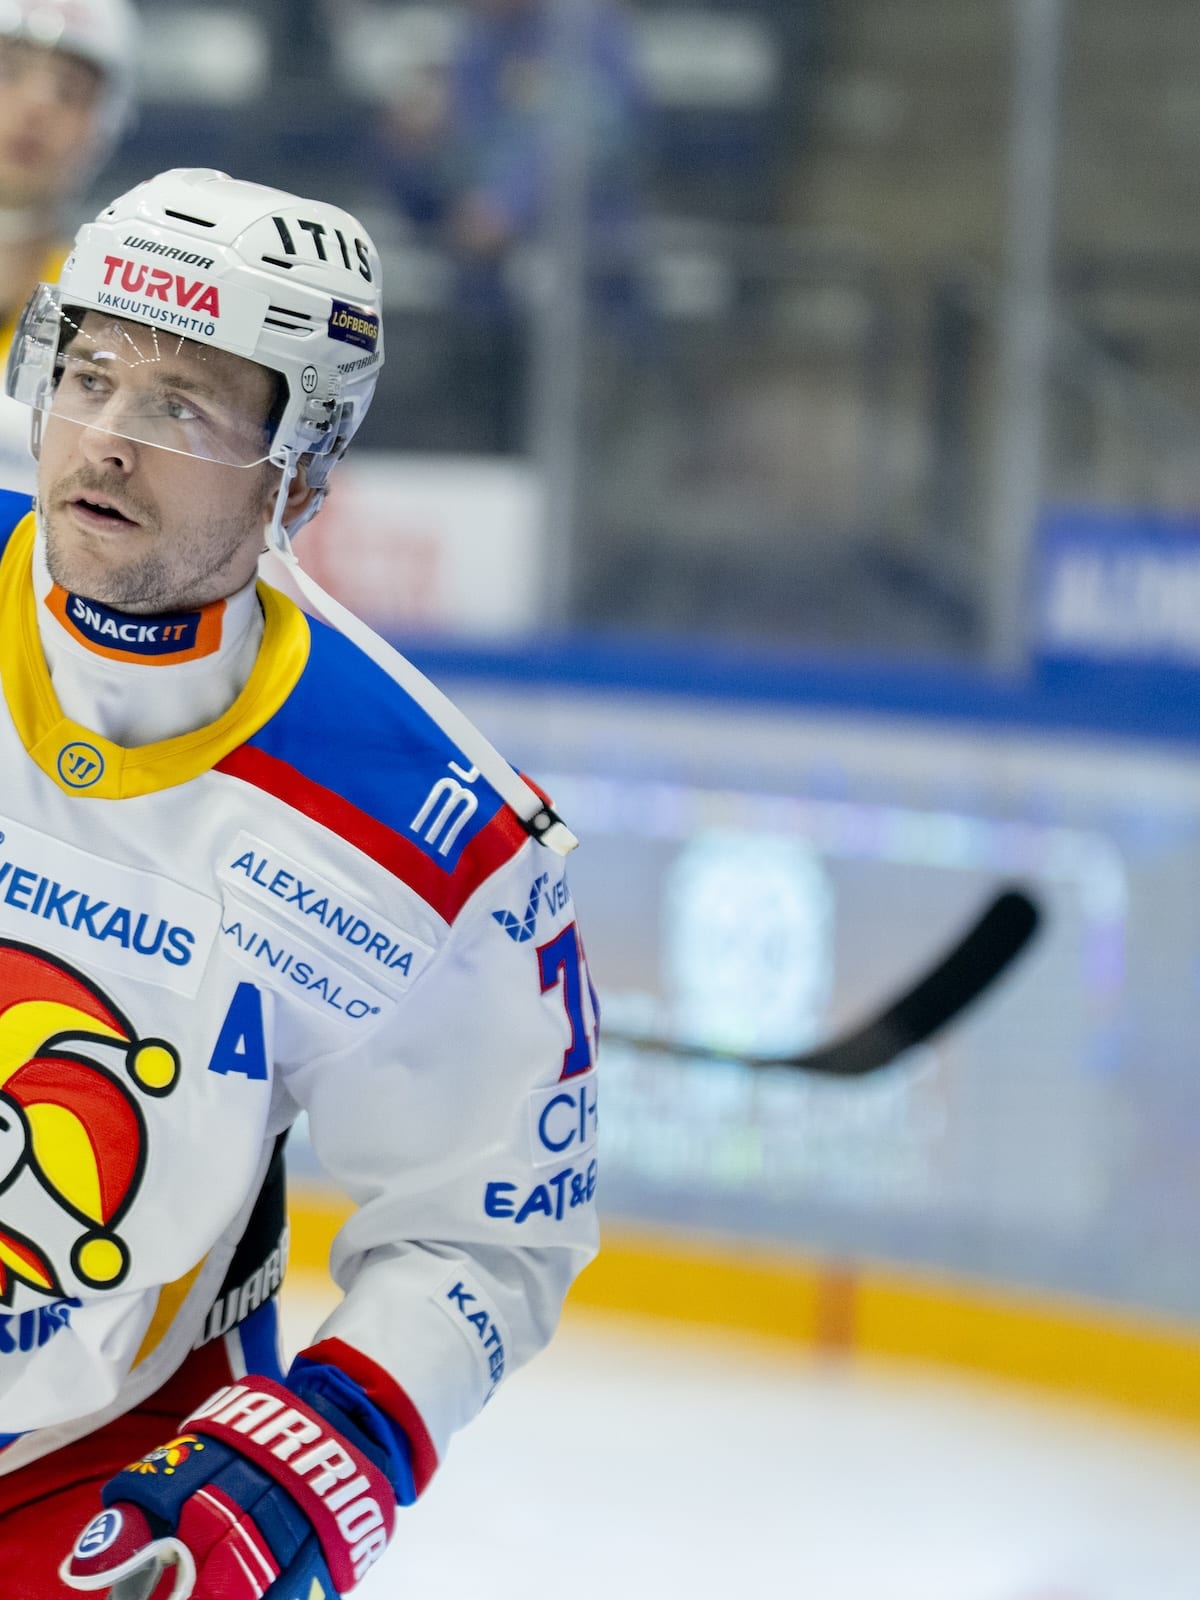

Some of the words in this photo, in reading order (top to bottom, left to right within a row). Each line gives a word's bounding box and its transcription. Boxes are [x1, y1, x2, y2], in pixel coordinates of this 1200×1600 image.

[123, 236, 215, 270] WARRIOR
[272, 216, 372, 283] ITIS
[98, 292, 215, 336] VAKUUTUSYHTIÖ
[104, 255, 220, 319] TURVA
[332, 310, 378, 338] LÖFBERGS
[231, 851, 414, 977] ALEXANDRIA
[222, 921, 372, 1019] AINISALO
[535, 920, 600, 1083] 7
[208, 981, 268, 1081] A
